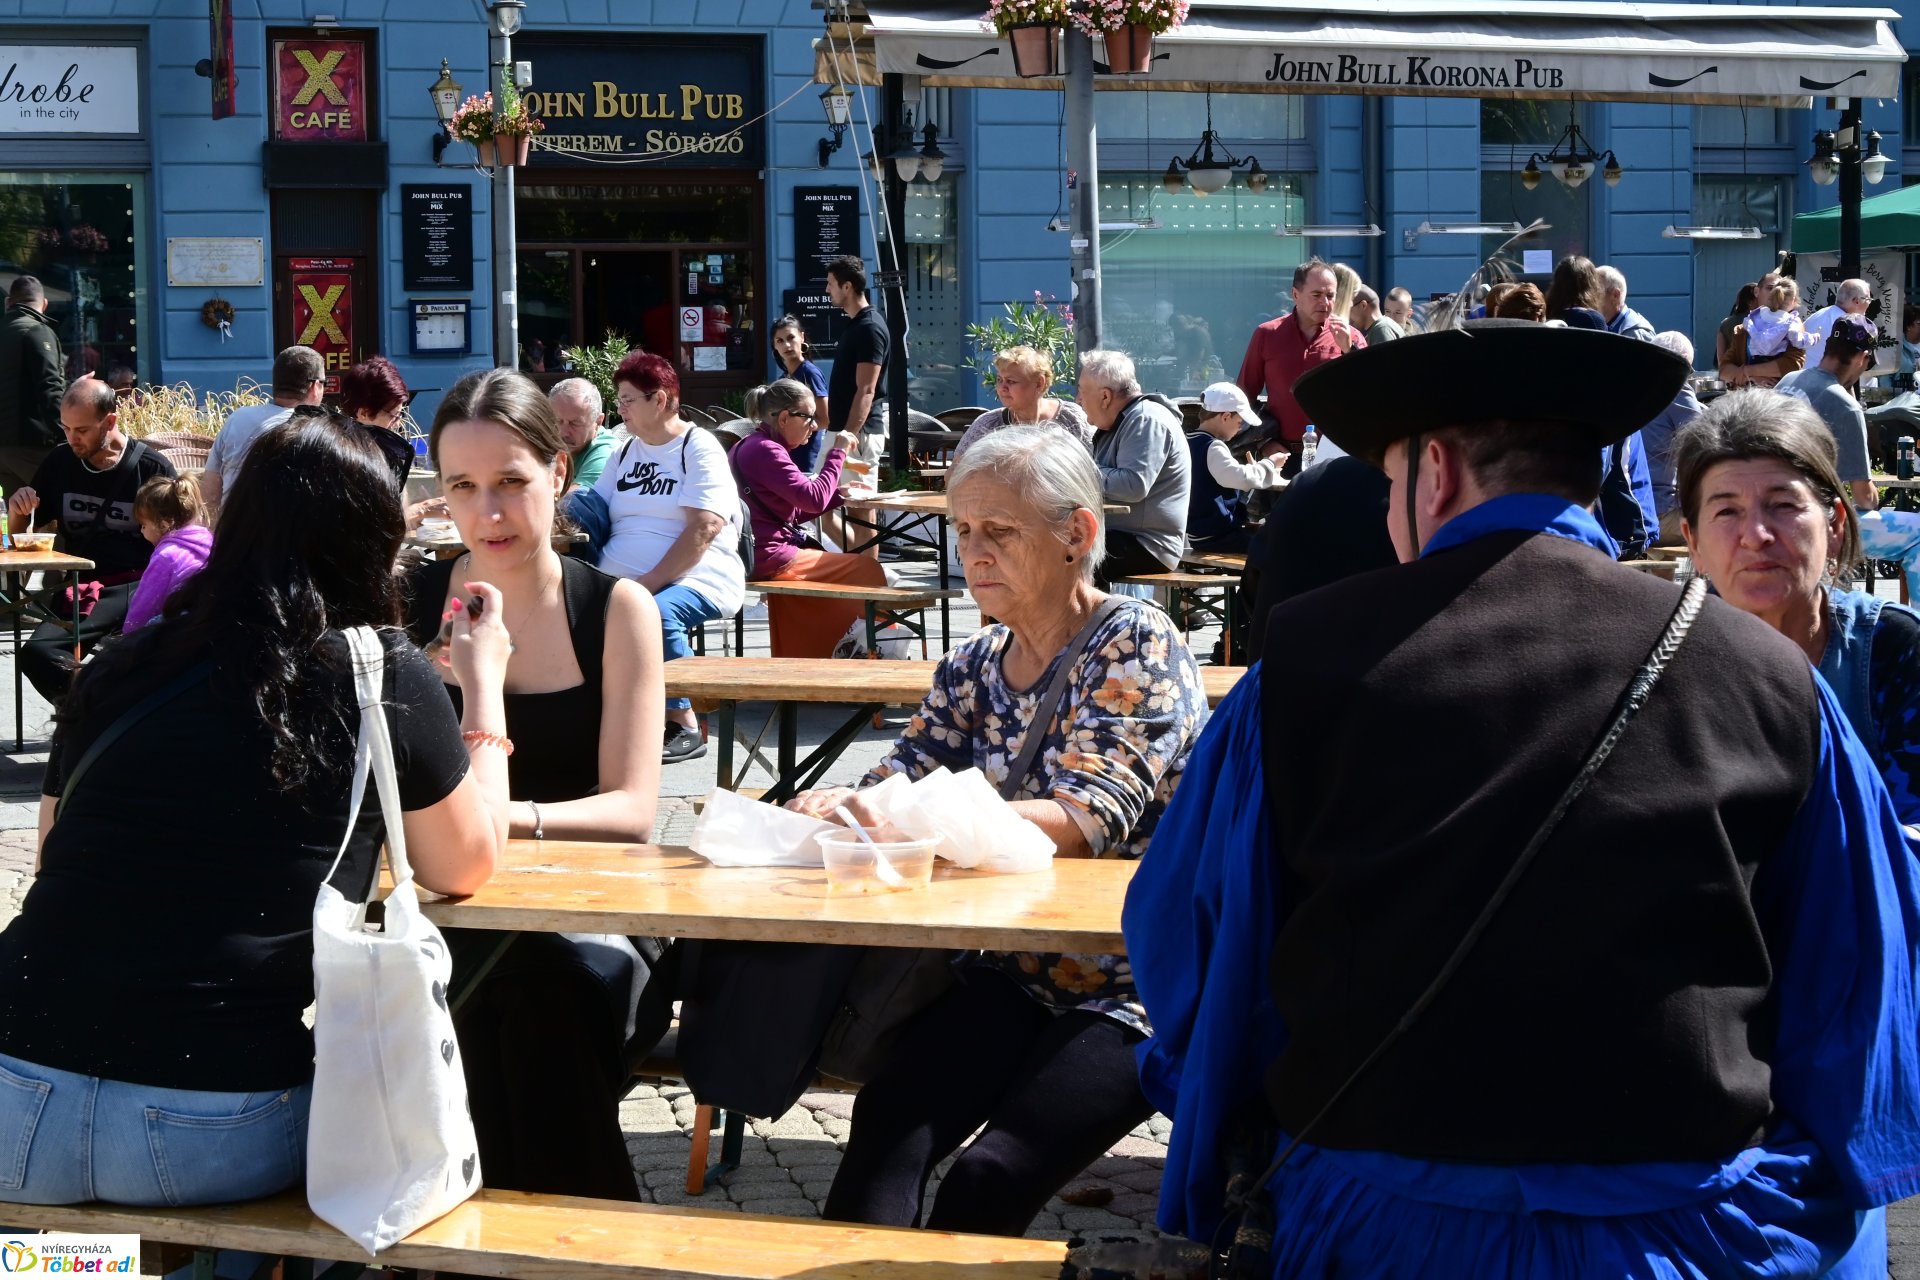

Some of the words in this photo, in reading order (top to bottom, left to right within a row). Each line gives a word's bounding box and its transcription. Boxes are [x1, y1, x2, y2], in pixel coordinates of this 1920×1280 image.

[290, 50, 350, 106] X
[1265, 53, 1333, 82] JOHN
[1335, 54, 1401, 85] BULL
[1405, 56, 1510, 88] KORONA
[1514, 59, 1564, 88] PUB
[523, 91, 586, 118] OHN
[592, 81, 675, 119] BULL
[679, 84, 744, 121] PUB
[20, 106, 31, 118] in
[35, 106, 55, 118] the
[59, 106, 80, 120] city
[290, 108, 352, 129] CAFÉ
[530, 135, 623, 152] TTEREM
[646, 129, 745, 154] SÖRÖZŐ
[796, 295, 820, 303] JOHN
[297, 285, 349, 345] X
[326, 348, 351, 370] FÉ
[627, 462, 660, 478] JUST
